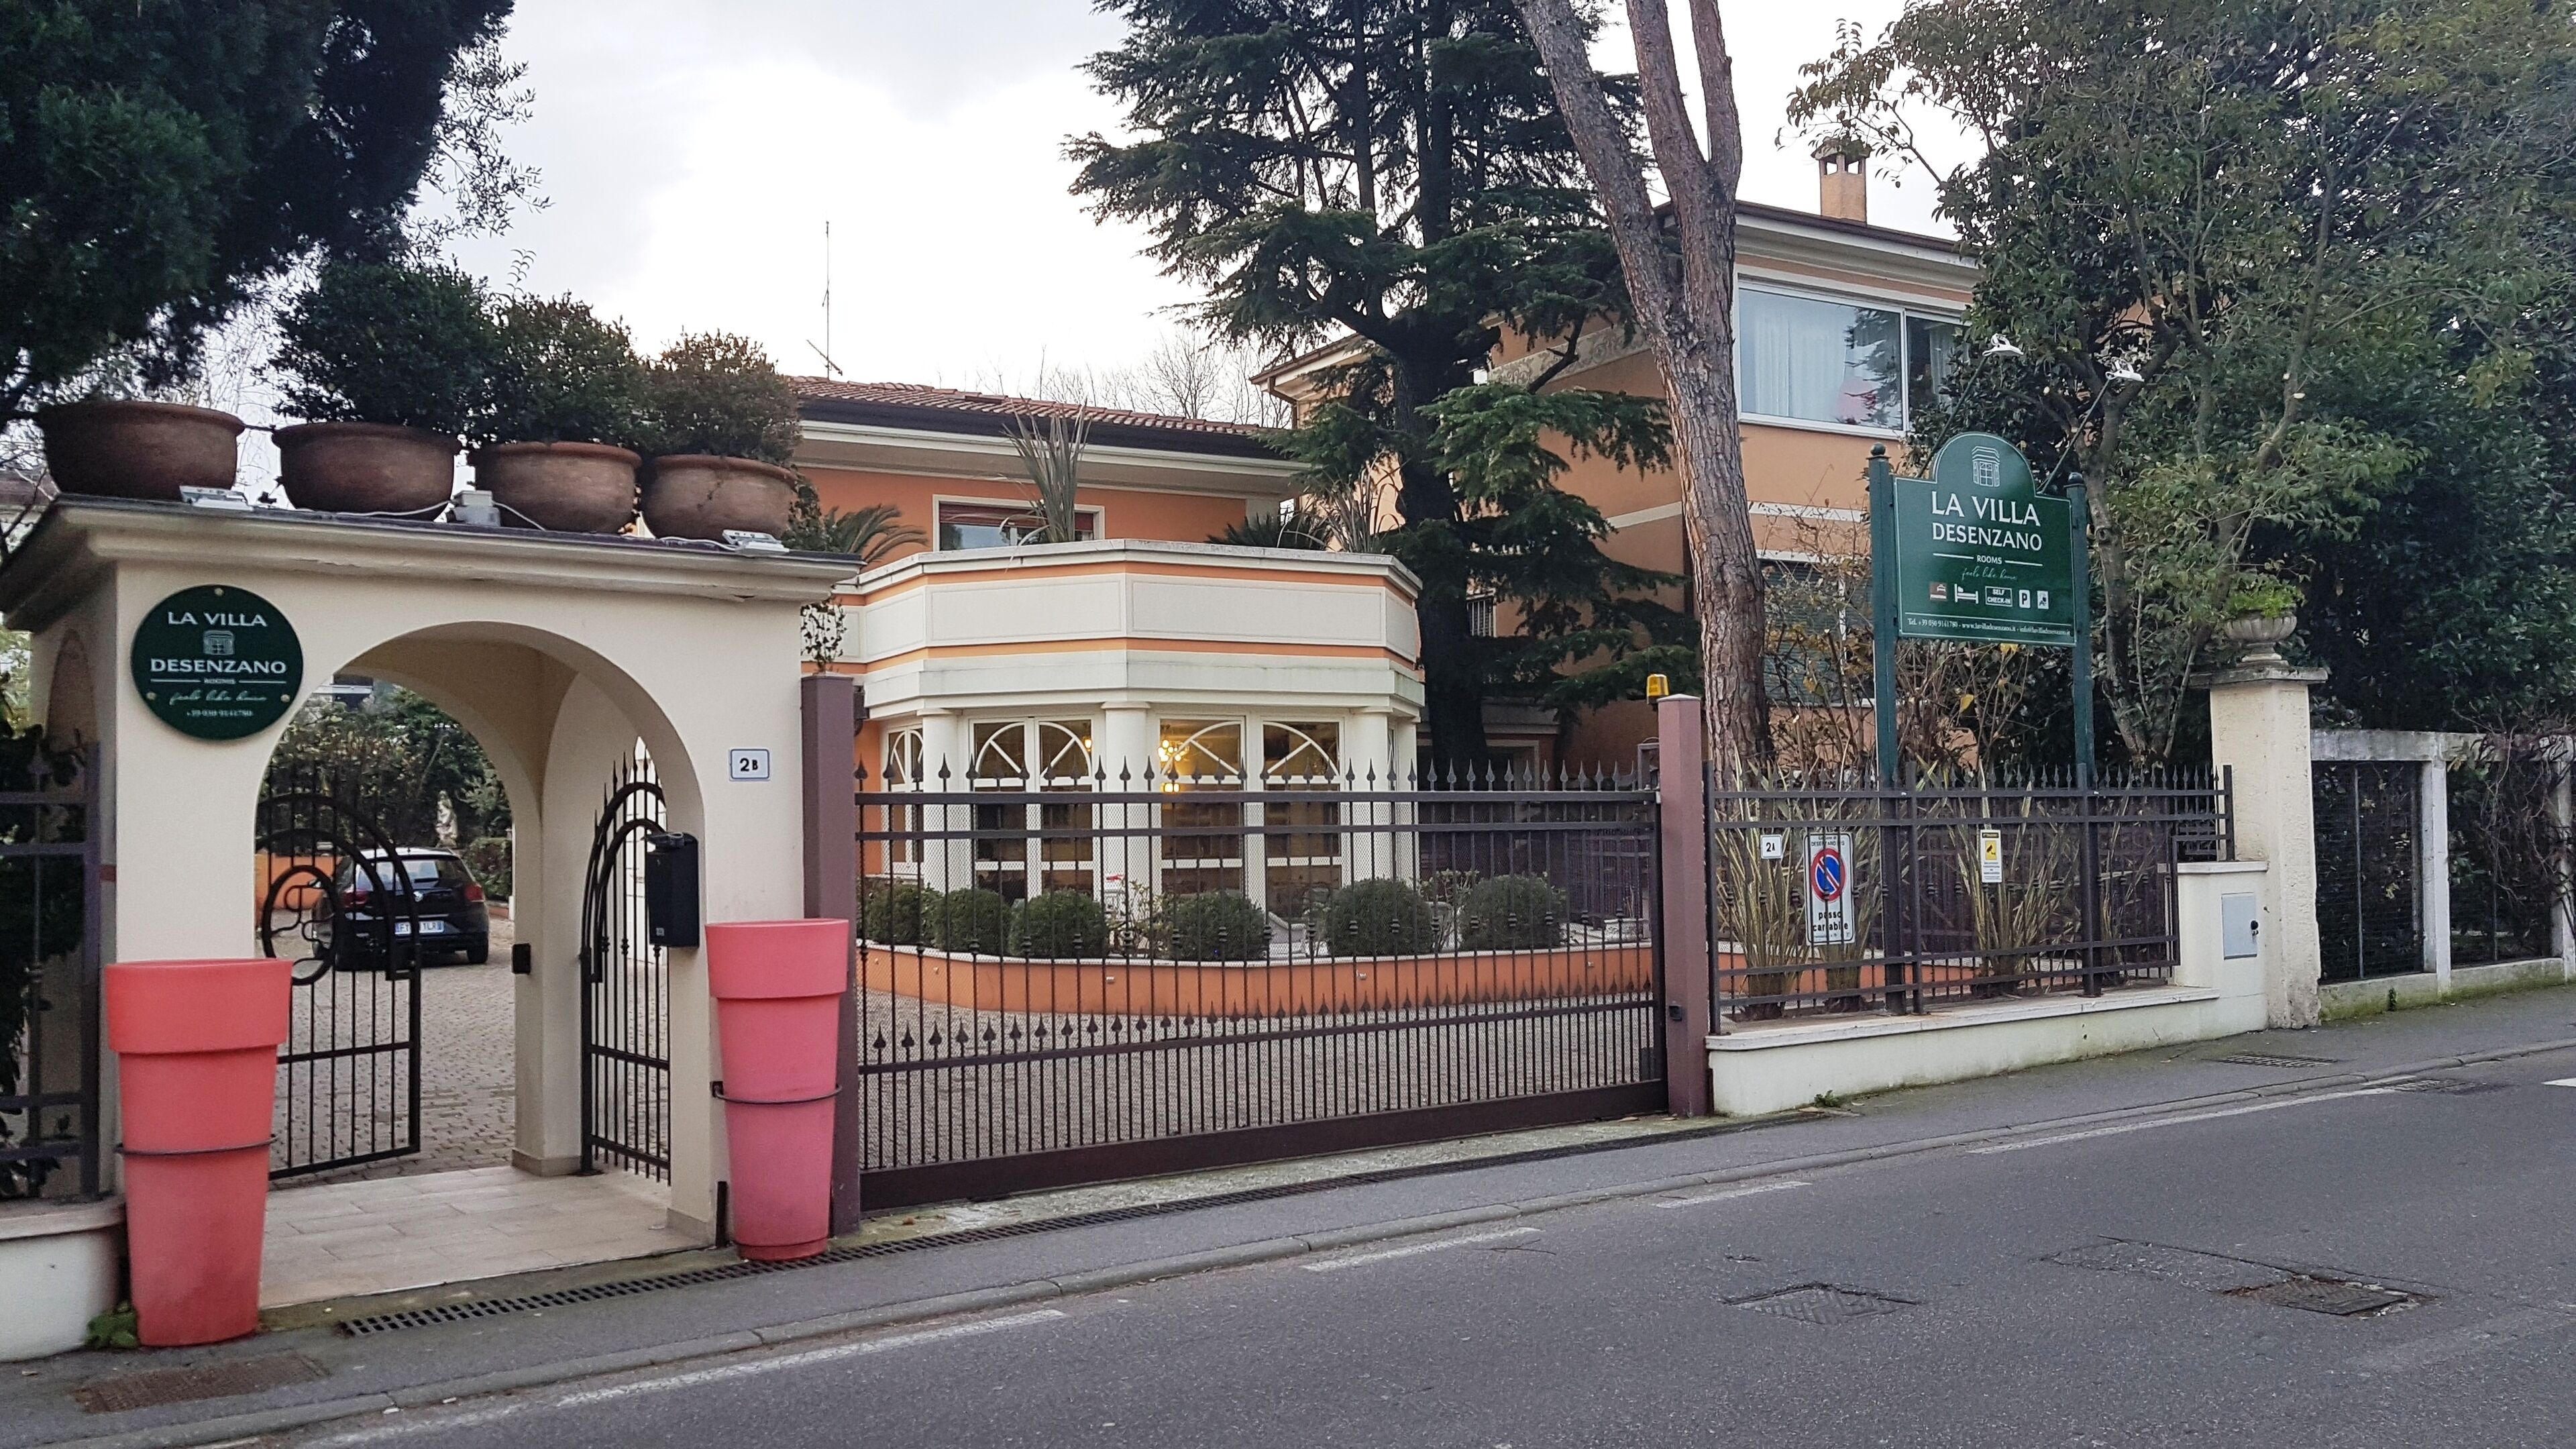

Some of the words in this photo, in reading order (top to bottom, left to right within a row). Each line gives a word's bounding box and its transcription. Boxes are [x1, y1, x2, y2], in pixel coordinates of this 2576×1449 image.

[1931, 490, 1965, 518] LA
[1971, 495, 2041, 527] VILLA
[1932, 522, 2042, 551] DESENZANO
[1977, 555, 2002, 565] ROOMS
[1962, 566, 1980, 581] feels
[1982, 566, 1996, 578] like
[2000, 569, 2017, 580] home
[168, 611, 198, 625] LA
[203, 612, 267, 627] VILLA
[150, 658, 286, 674] DESENZANO
[739, 757, 759, 772] 2B
[1813, 921, 1848, 932] carabie
